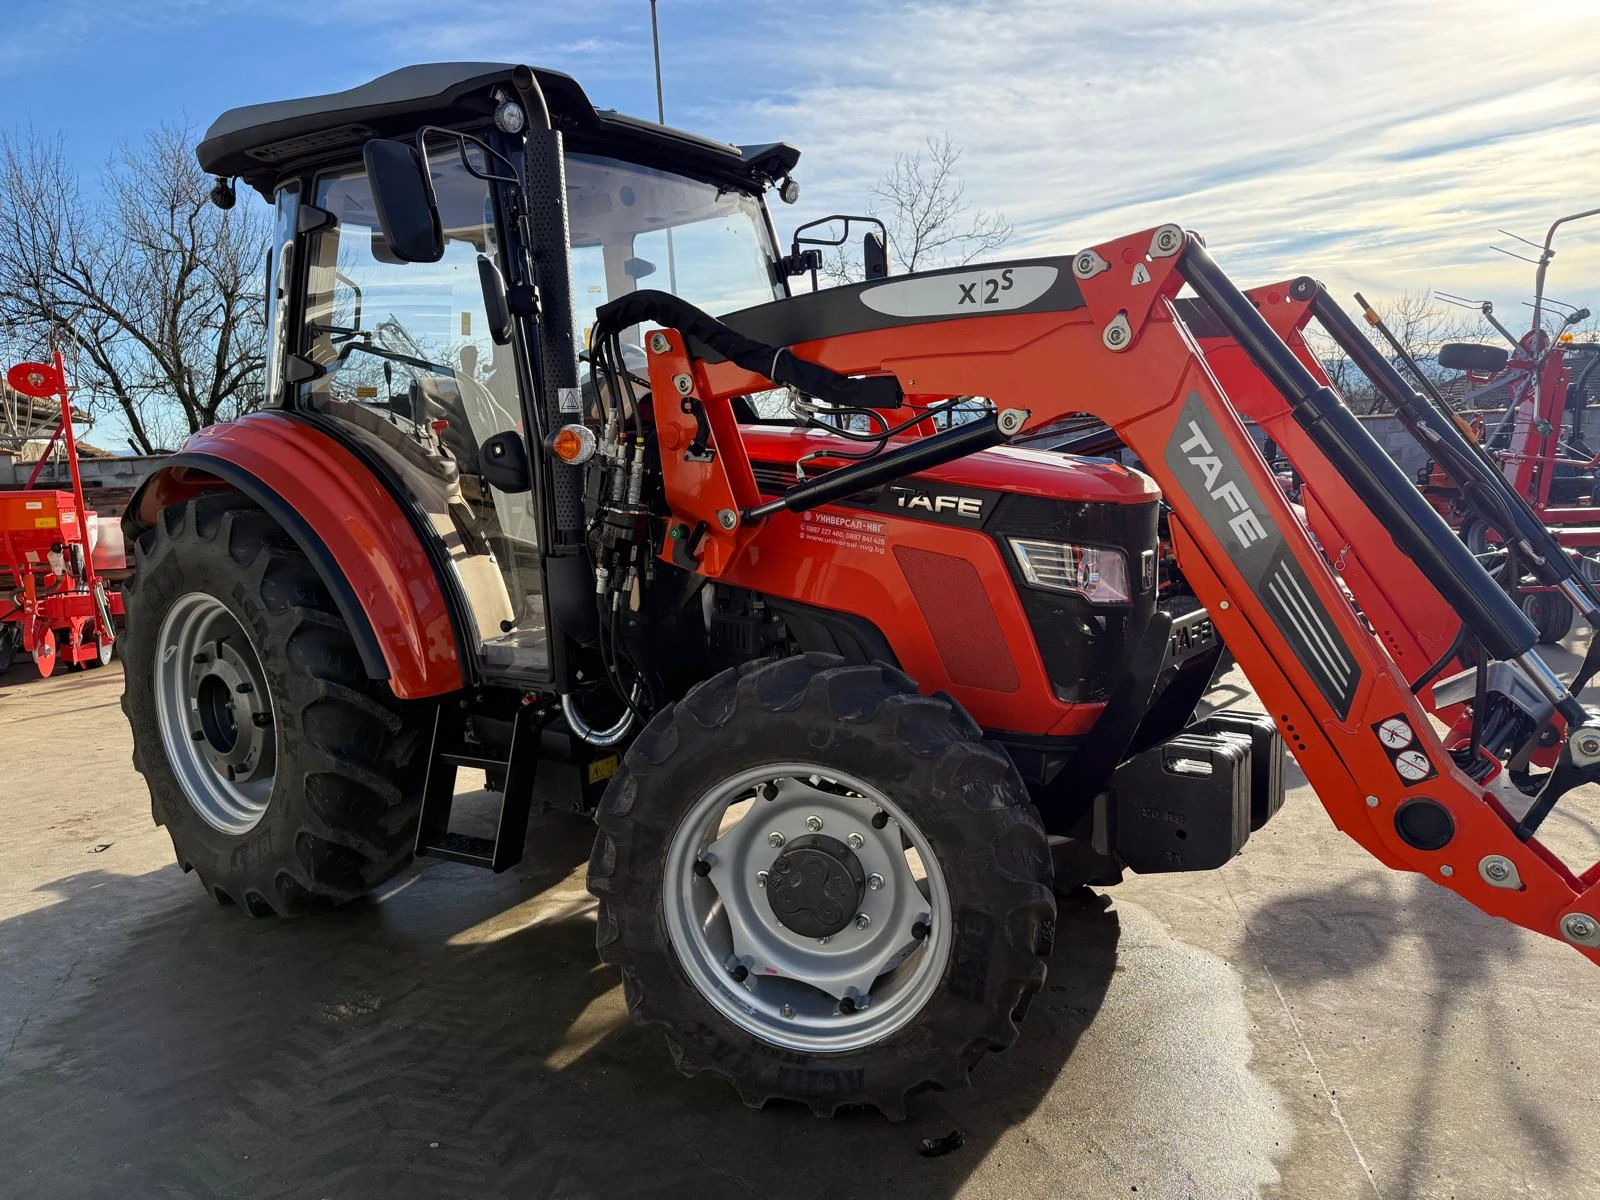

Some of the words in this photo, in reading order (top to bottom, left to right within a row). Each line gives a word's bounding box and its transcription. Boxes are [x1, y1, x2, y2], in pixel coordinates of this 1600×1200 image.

[1180, 420, 1268, 549] TAFE
[890, 486, 983, 519] TAFE
[815, 513, 883, 533] УНИВЕРСАЛ-НВГ
[805, 534, 885, 555] www.universal-nvg.bg
[1172, 617, 1212, 656] TAFE
